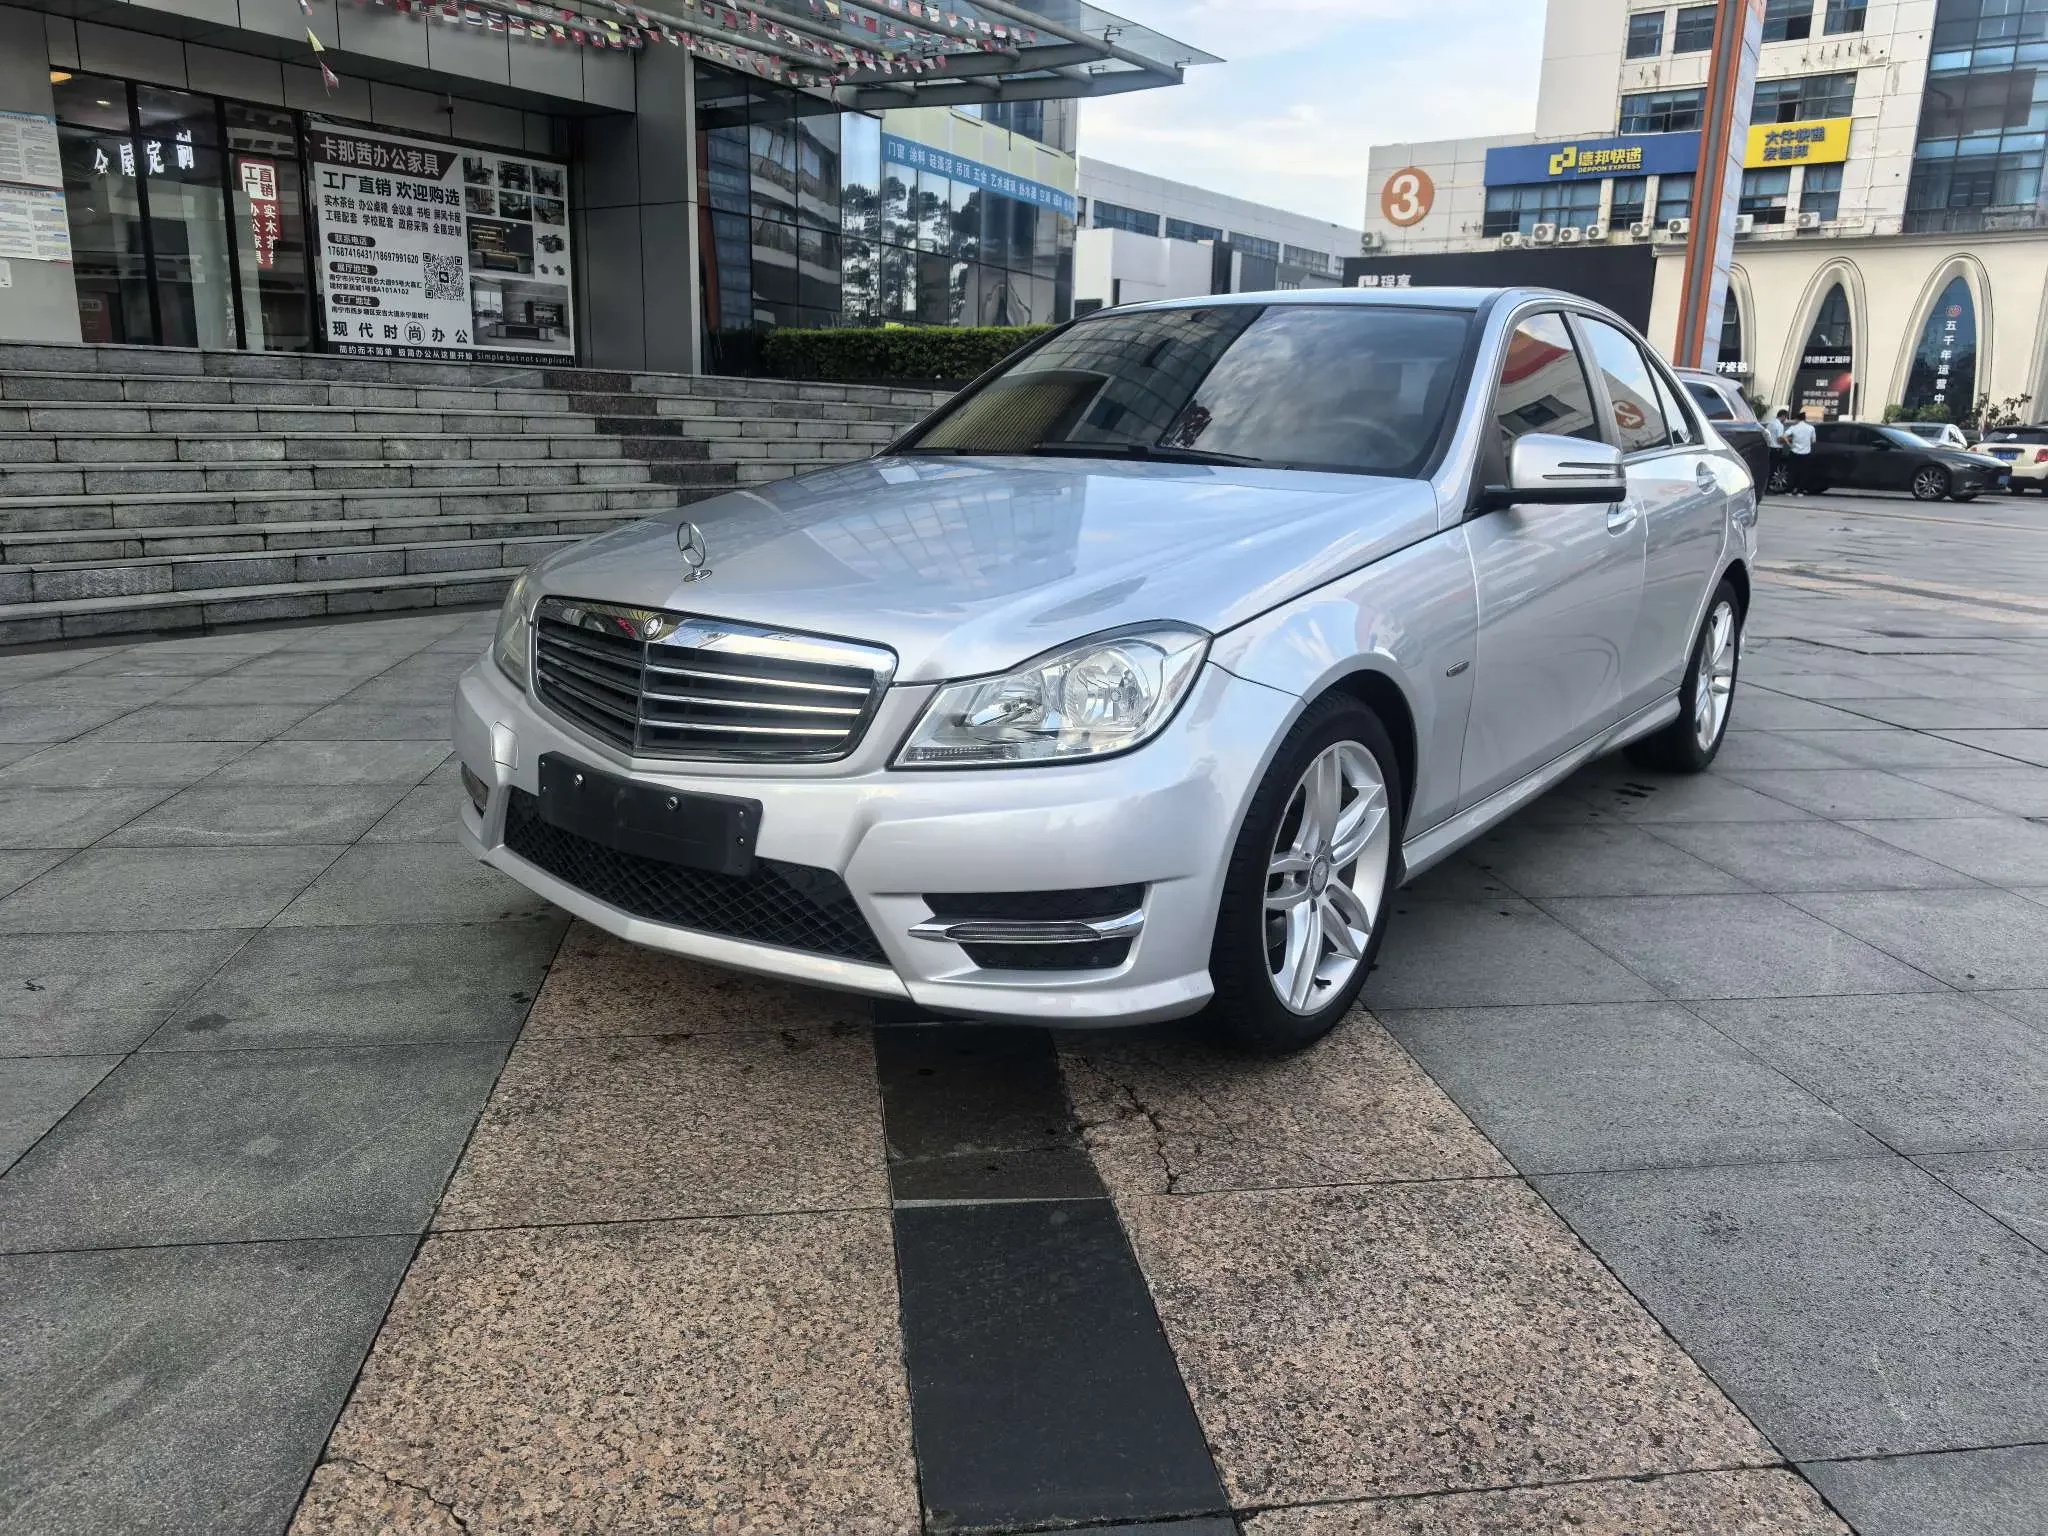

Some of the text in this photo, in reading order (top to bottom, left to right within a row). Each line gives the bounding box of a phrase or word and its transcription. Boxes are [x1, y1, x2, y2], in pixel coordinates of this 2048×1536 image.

[1765, 126, 1825, 146] 大件快递
[94, 129, 194, 176] 全屋定制
[320, 136, 440, 176] 卡那茜办公家具
[1579, 147, 1642, 167] 德邦快递
[1763, 144, 1809, 161] 发德邦
[1609, 163, 1641, 171] EXPRESS
[322, 170, 460, 207] 工厂直销 欢迎购选
[1390, 173, 1420, 220] 3
[333, 321, 469, 345] 现代时尚办公
[476, 352, 504, 362] Simple
[1934, 320, 1958, 405] 五千年运营中
